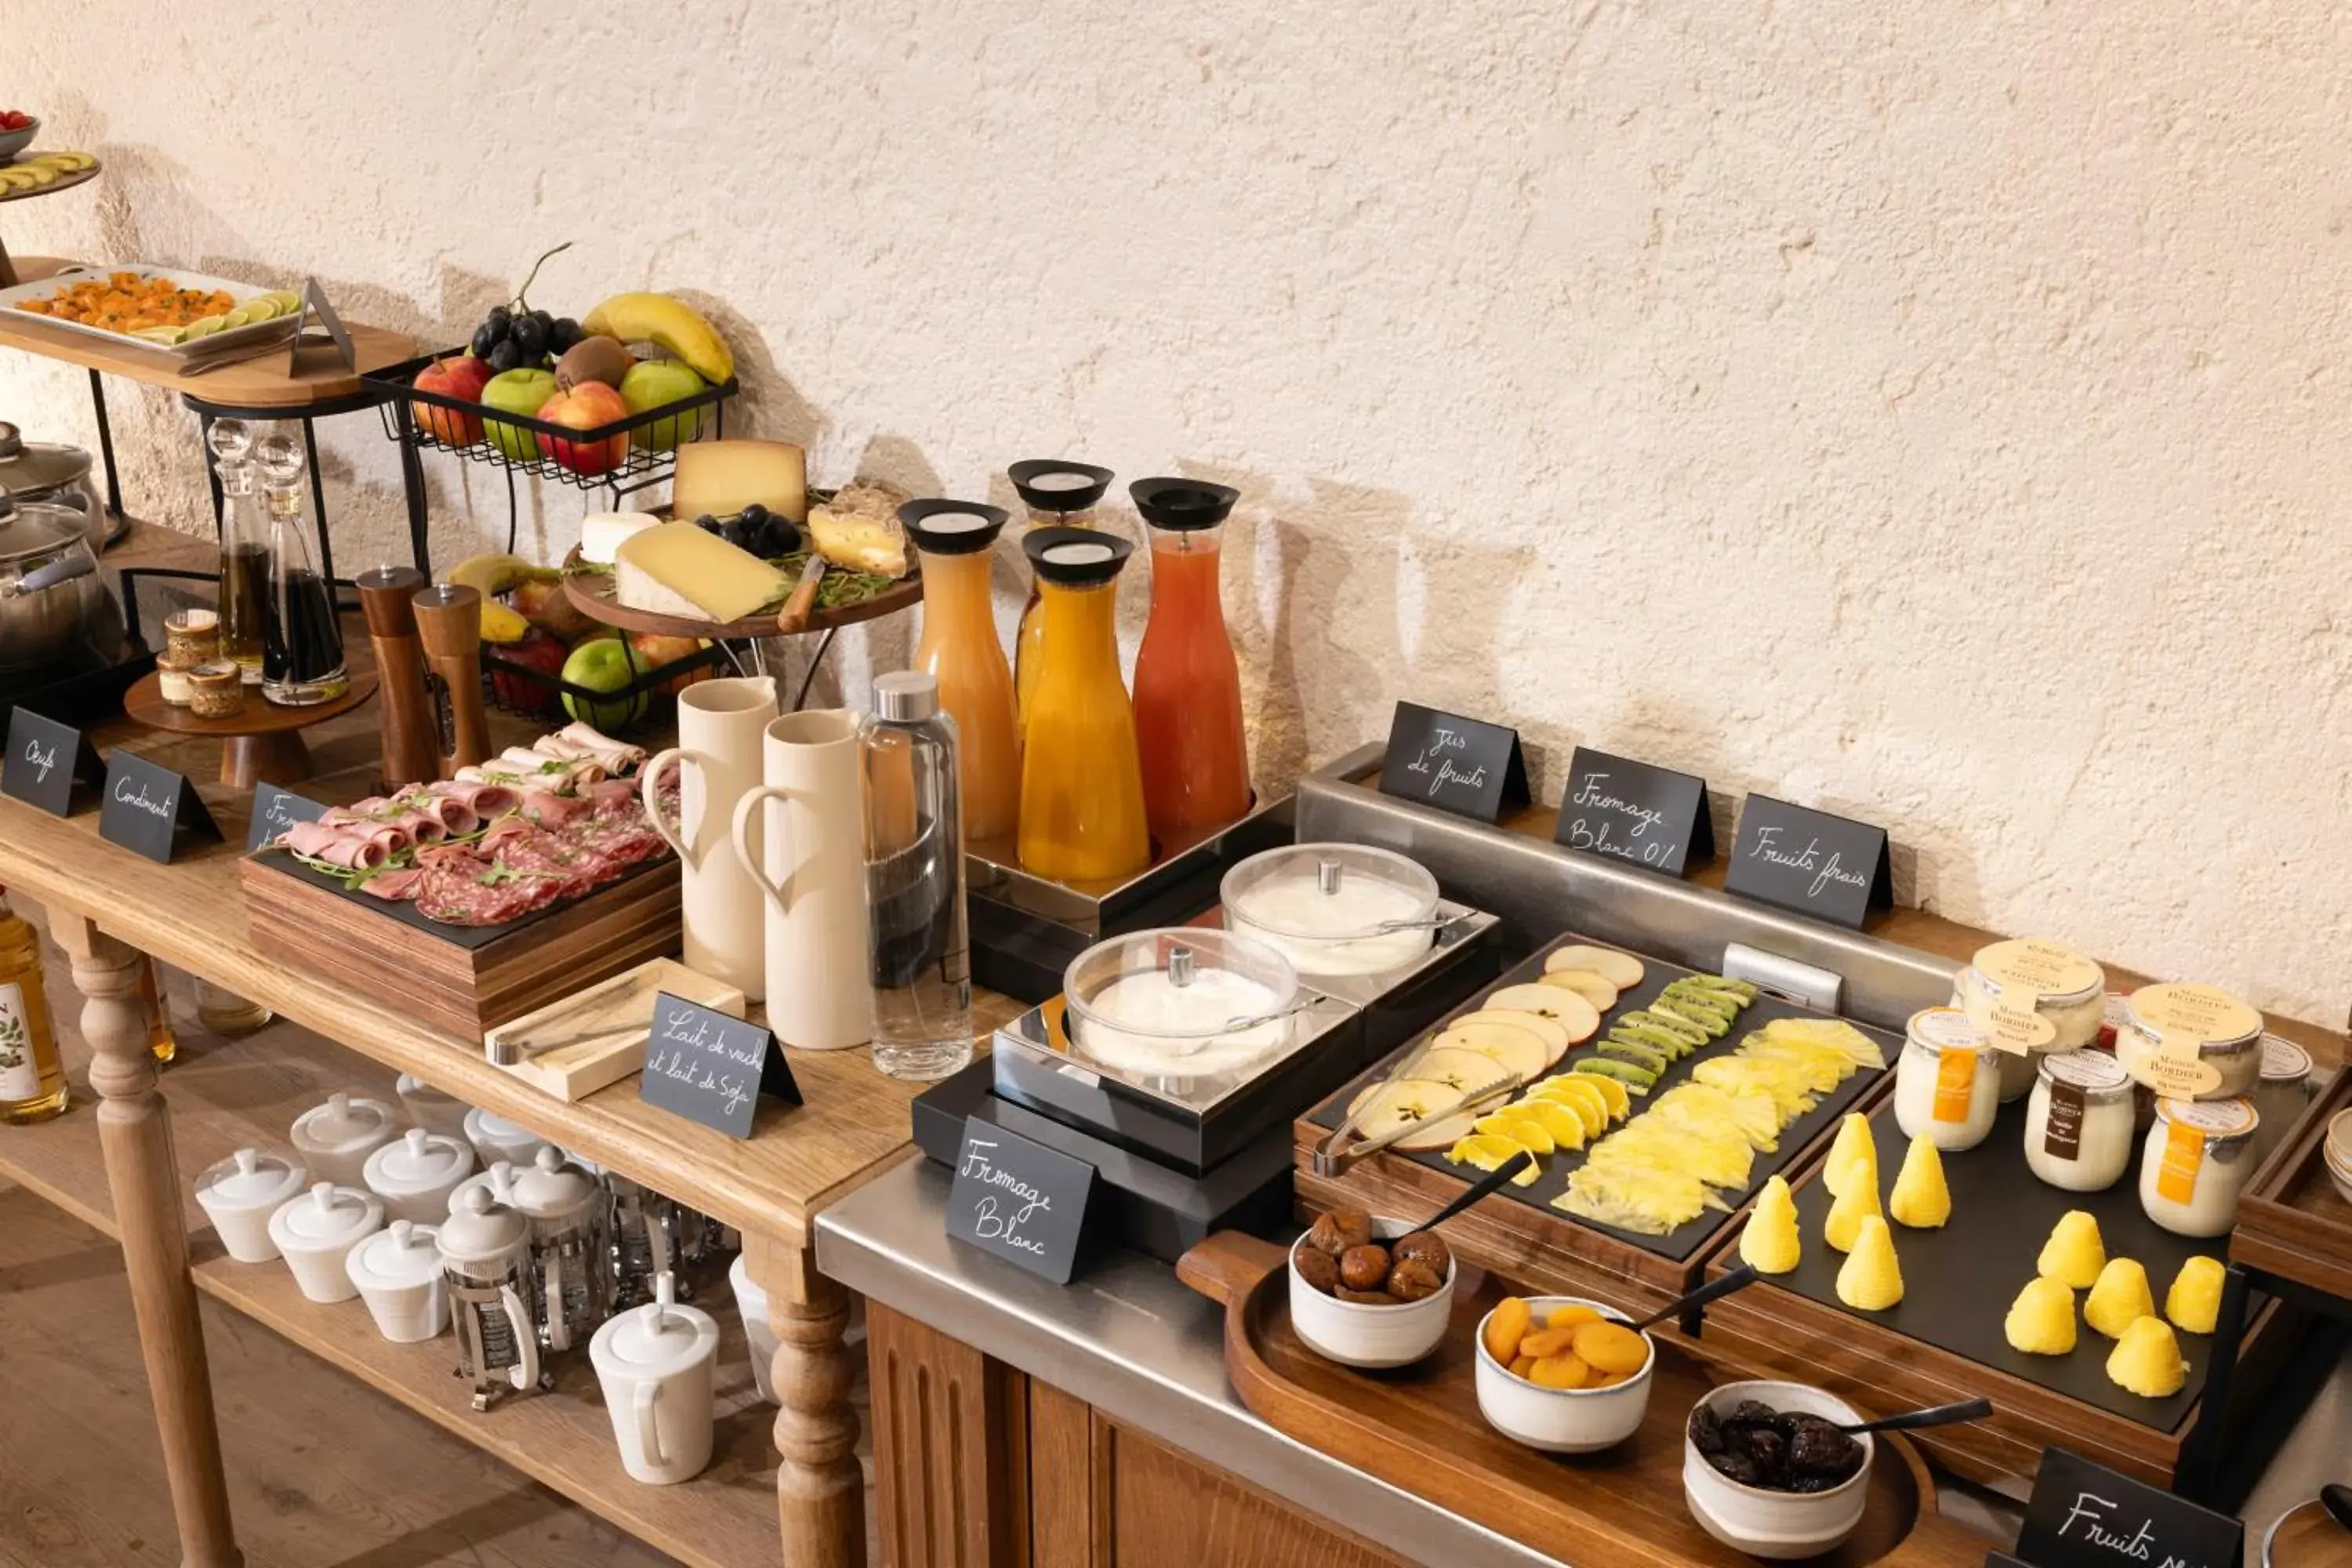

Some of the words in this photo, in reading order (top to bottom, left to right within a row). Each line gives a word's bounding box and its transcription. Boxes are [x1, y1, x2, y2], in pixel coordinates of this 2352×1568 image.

[1429, 728, 1466, 756] Jus
[1428, 758, 1486, 797] fruits
[1573, 774, 1663, 837] Fromage
[1570, 818, 1635, 858] Blanc
[1750, 826, 1820, 870] Fruits
[1807, 852, 1866, 898] frais
[662, 1010, 709, 1047] Lait
[708, 1030, 725, 1055] de
[648, 1049, 666, 1073] et
[665, 1052, 699, 1083] lait
[699, 1072, 716, 1089] de
[962, 1138, 1051, 1223] Fromage
[975, 1196, 1045, 1255] Blanc
[2058, 1492, 2156, 1561] Fruits
